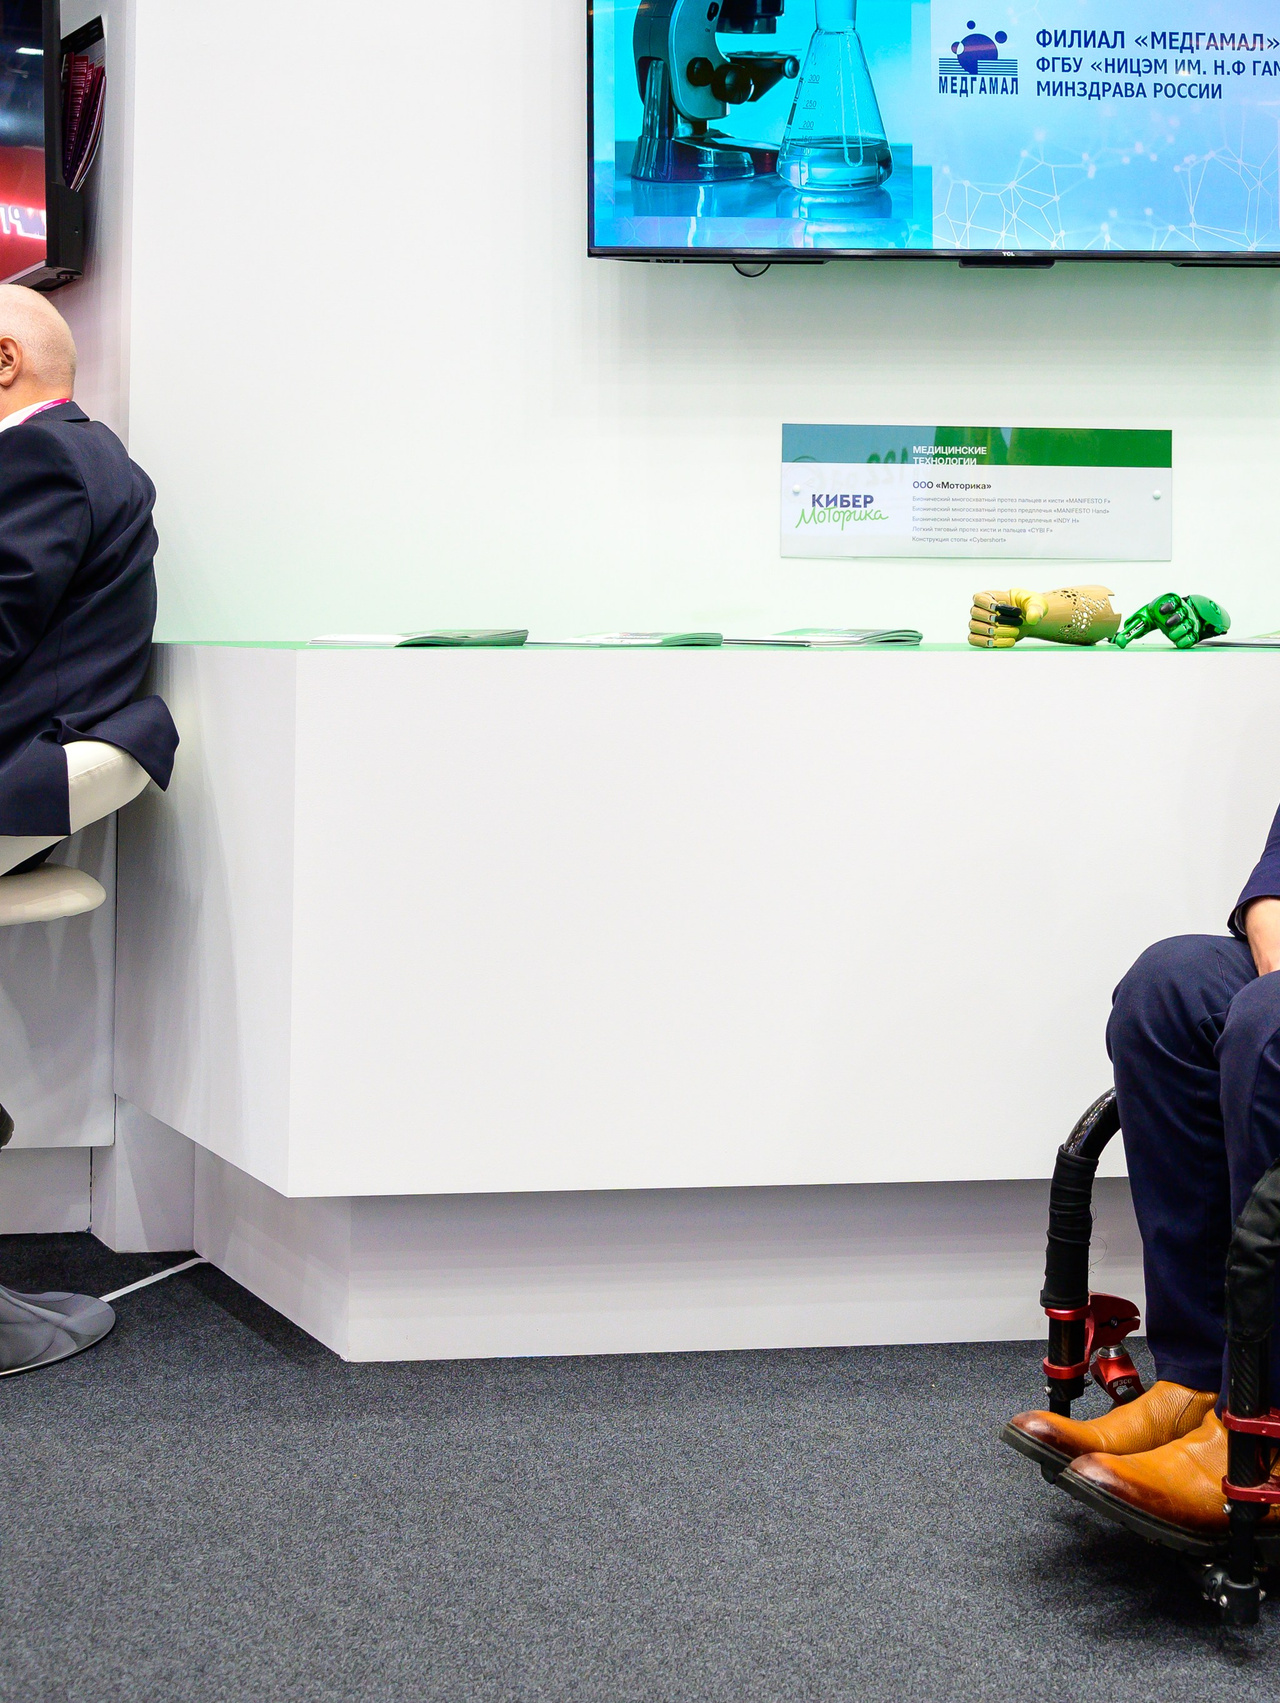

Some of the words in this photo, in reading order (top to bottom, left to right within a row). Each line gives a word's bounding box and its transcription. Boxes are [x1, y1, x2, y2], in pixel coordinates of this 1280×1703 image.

[1036, 29, 1125, 49] ФИЛИАЛ
[1134, 31, 1280, 54] «МЕДГАМАЛ»
[1036, 56, 1083, 73] ФГБУ
[1090, 57, 1168, 77] «НИЦЭМ
[1174, 59, 1207, 75] ИМ.
[1213, 59, 1246, 76] Н.Ф
[938, 75, 1019, 98] МЕДГАМАЛ
[1036, 80, 1147, 100] МИНЗДРАВА
[1153, 82, 1222, 99] РОССИИ
[912, 445, 987, 455] МЕДИЦИНСКИЕ
[912, 457, 977, 466] ТЕХНОЛОГИИ
[912, 481, 934, 489] ООО
[935, 481, 992, 491] «Моторика»
[811, 494, 875, 508] КИБЕР
[795, 506, 889, 531] Моторика
